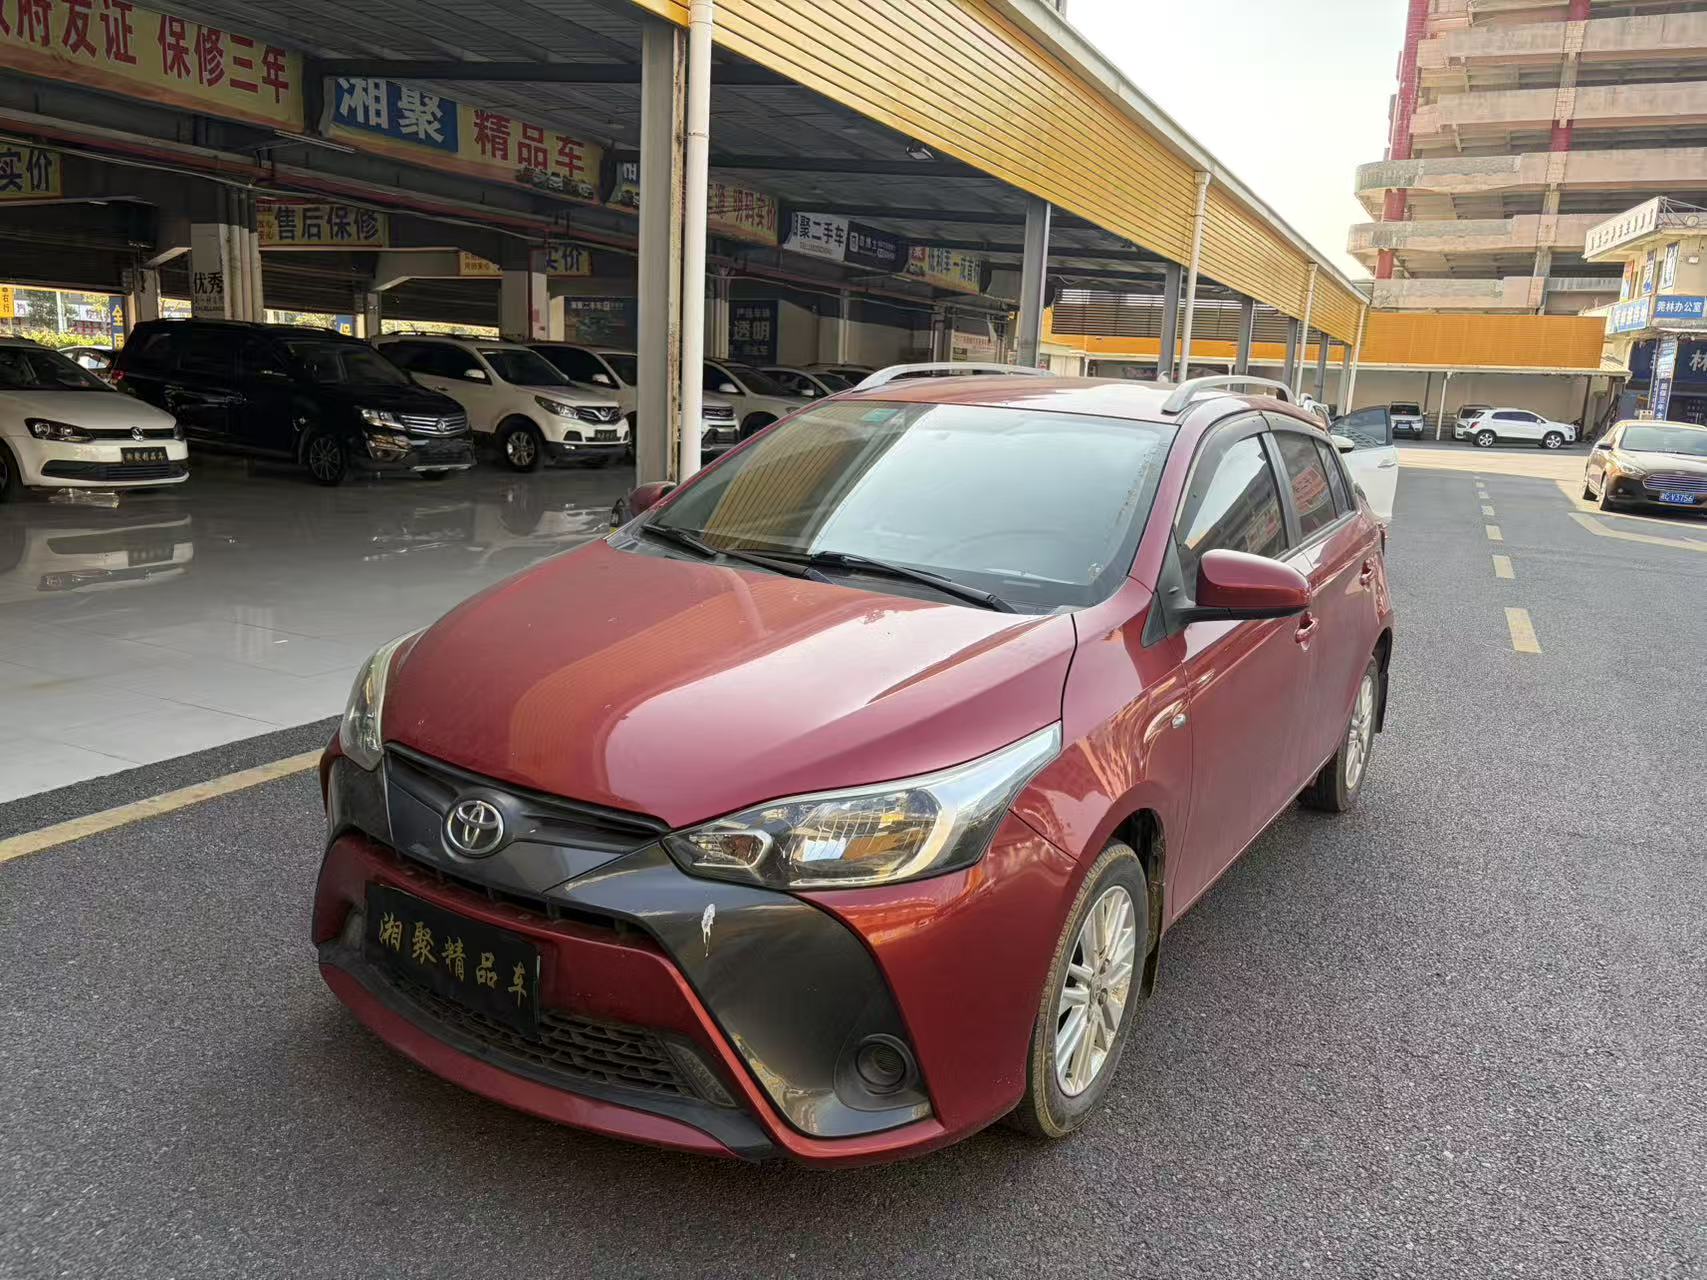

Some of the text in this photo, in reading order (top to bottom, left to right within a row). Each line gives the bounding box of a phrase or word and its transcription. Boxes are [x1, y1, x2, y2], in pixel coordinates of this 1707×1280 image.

[0, 0, 289, 104] 府发证 保修三年
[338, 78, 585, 178] 湘聚 精品车
[274, 206, 378, 241] 售后保修
[194, 271, 223, 294] 优秀
[732, 320, 770, 340] 透明
[378, 911, 528, 1009] 湘聚精品车
